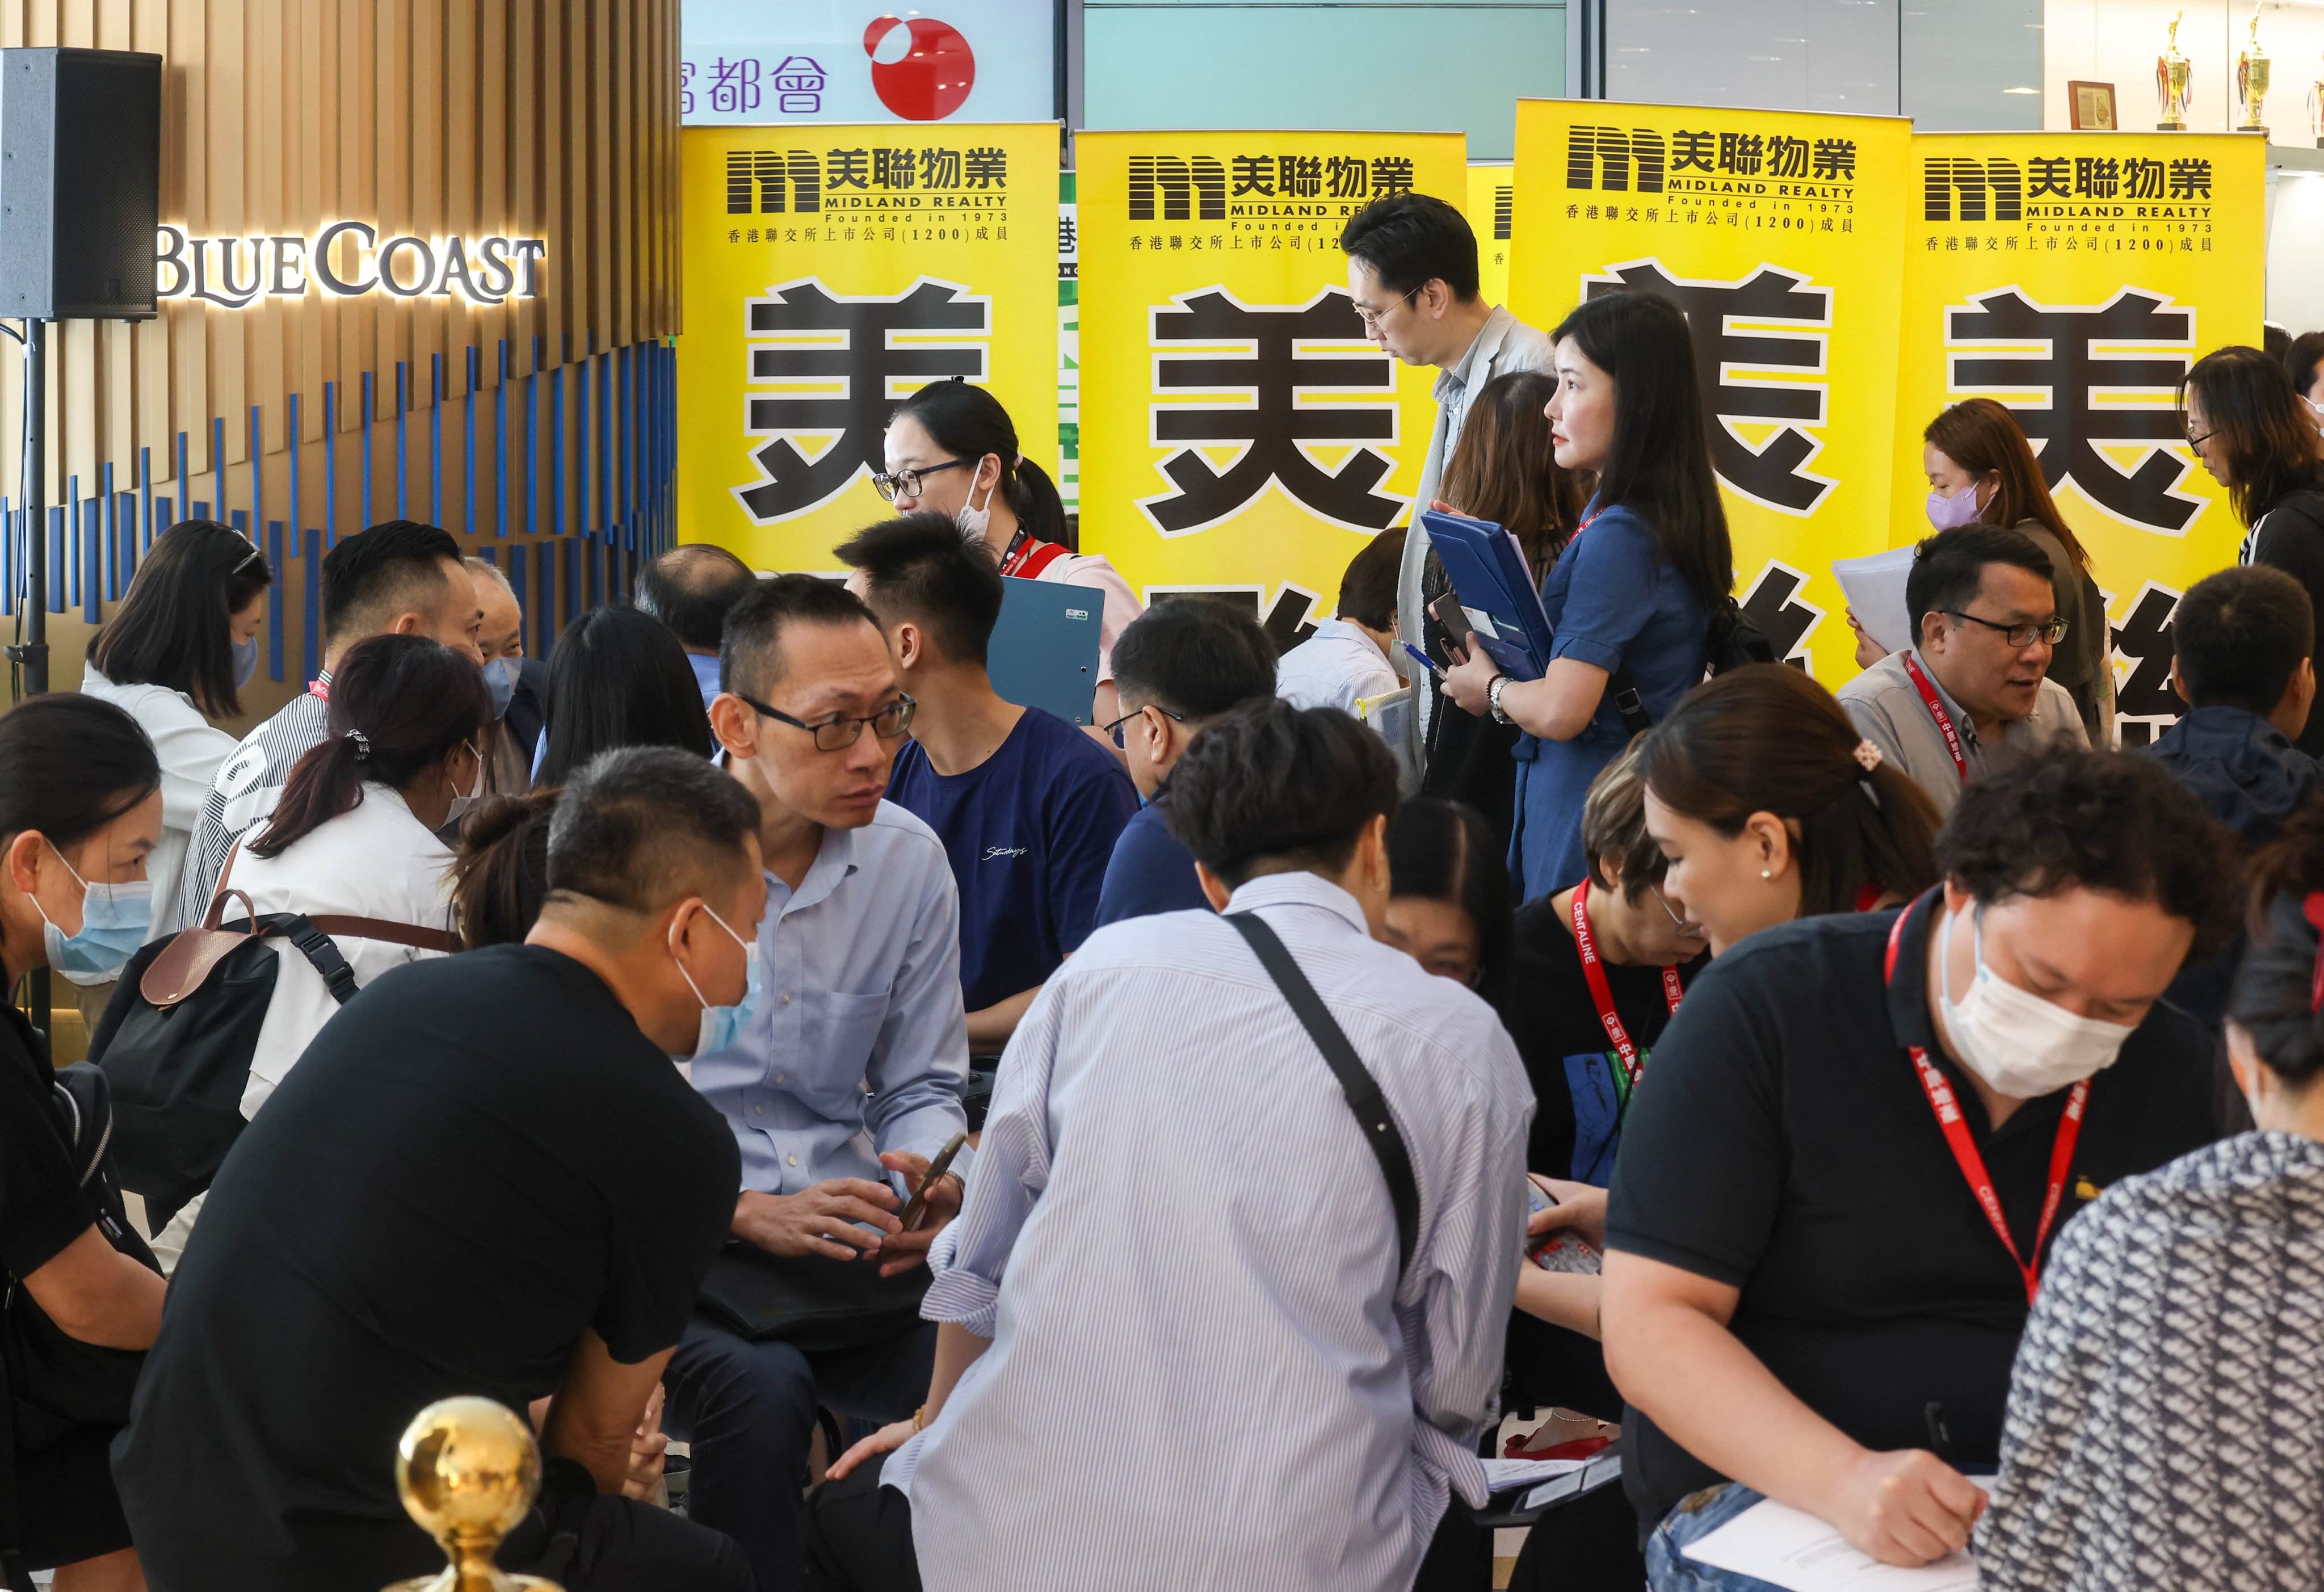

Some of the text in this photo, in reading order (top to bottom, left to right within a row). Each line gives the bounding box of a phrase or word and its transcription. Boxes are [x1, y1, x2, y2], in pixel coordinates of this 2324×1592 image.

[682, 56, 829, 114] 都會
[1670, 130, 1856, 180] 美聯物業
[826, 148, 1006, 190] 美聯物業
[1231, 155, 1415, 199] 美聯物業
[2027, 157, 2211, 199] 美聯物業
[1668, 179, 1854, 199] MIDLAND REALTY
[825, 197, 1006, 207] MIDLAND REALTY
[1231, 205, 1361, 217] MIDLAND RE
[1669, 195, 1854, 214] Founded in 1973
[928, 213, 944, 222] in
[2027, 207, 2210, 217] MIDLAND REALTY
[1231, 221, 1317, 230] Founded
[1129, 235, 1339, 252] 香港聯交所上市公司(12
[1905, 662, 1915, 675] INE
[1573, 901, 1596, 965] CENTALINE
